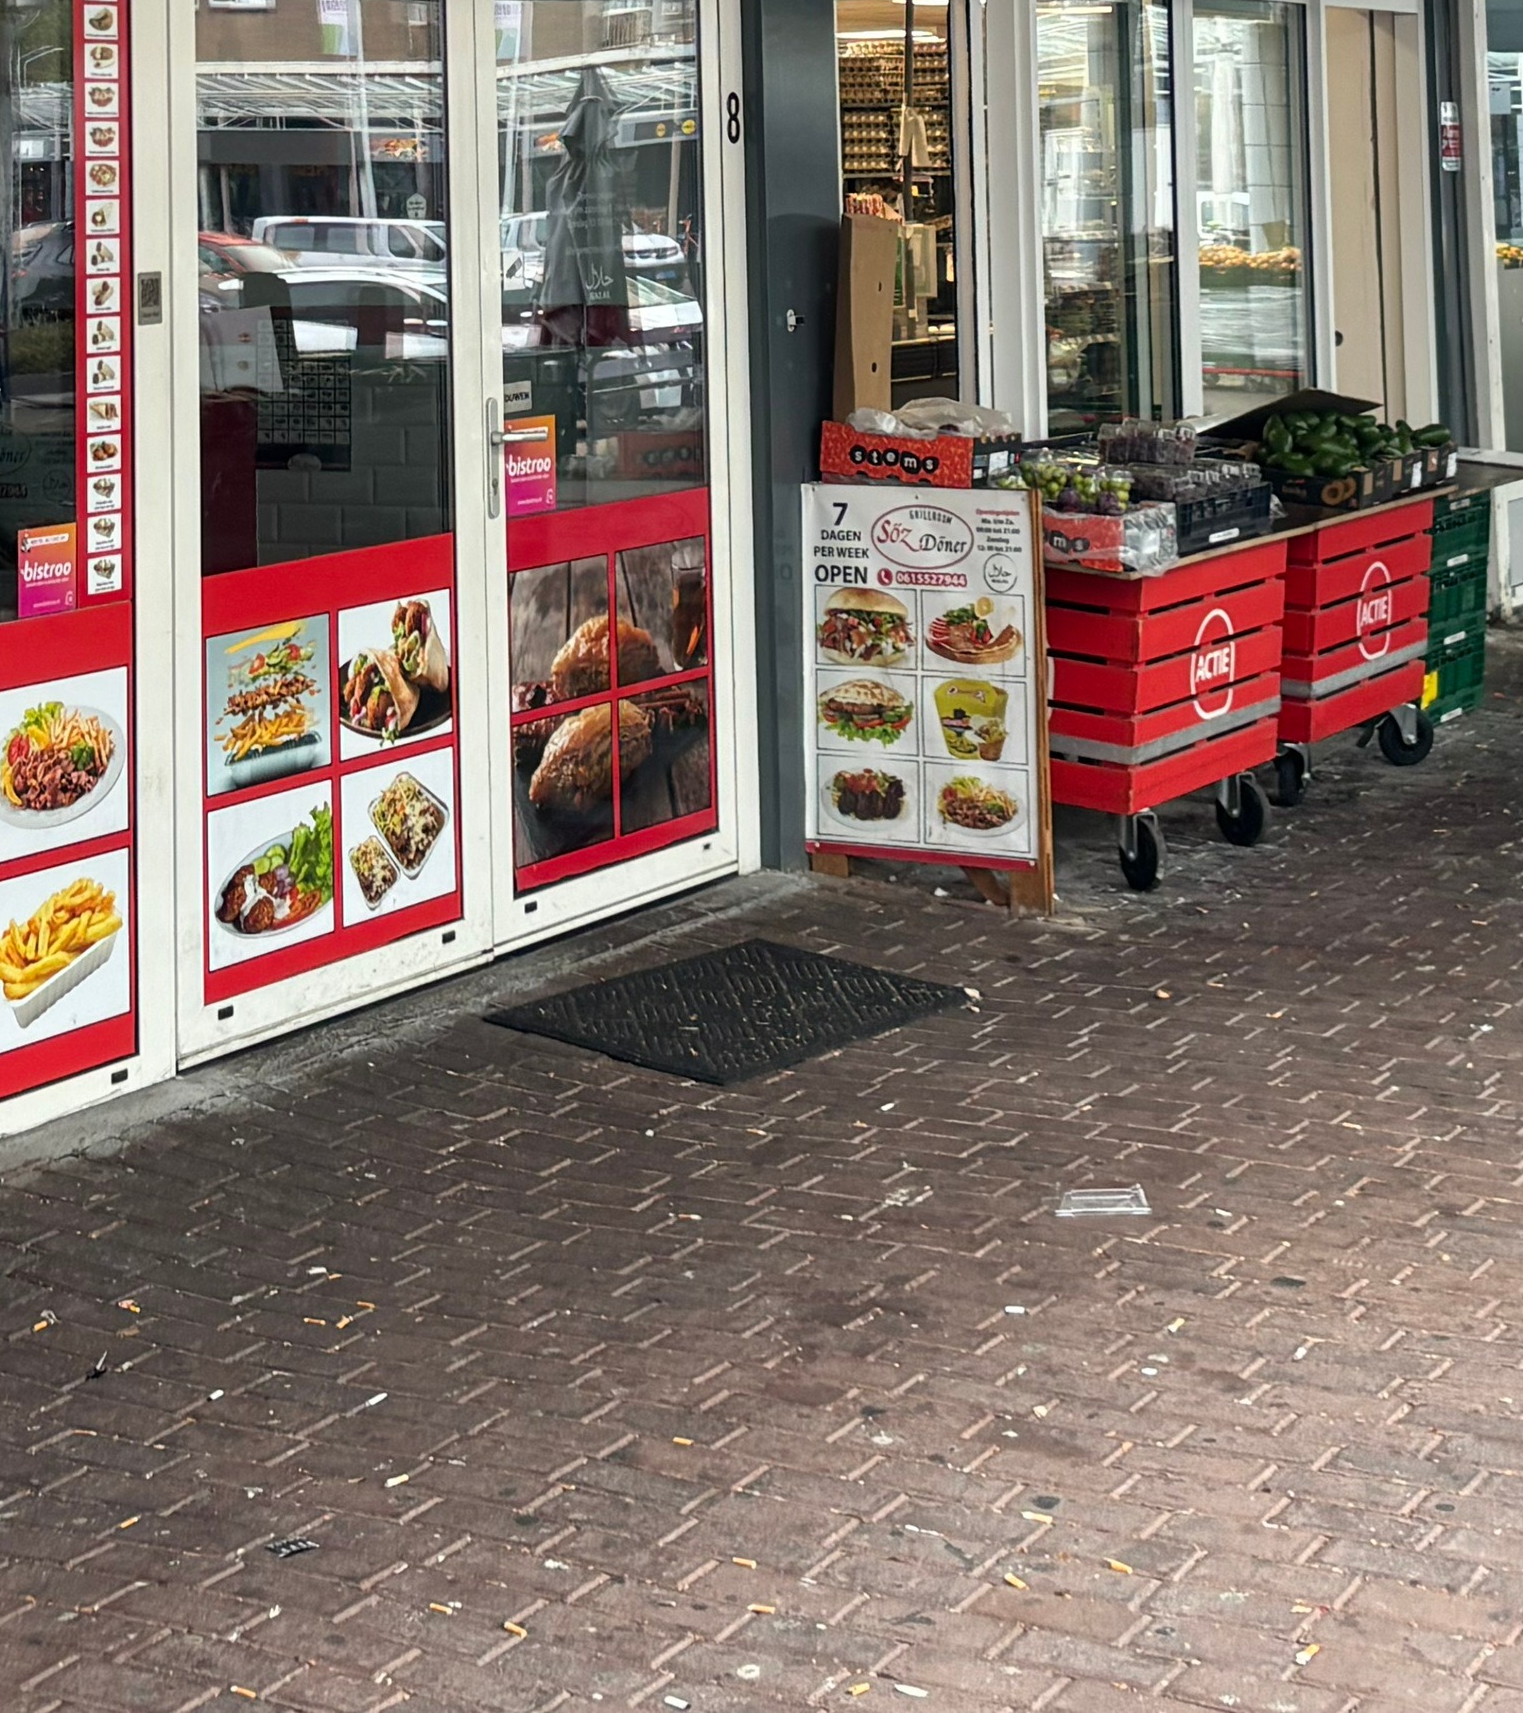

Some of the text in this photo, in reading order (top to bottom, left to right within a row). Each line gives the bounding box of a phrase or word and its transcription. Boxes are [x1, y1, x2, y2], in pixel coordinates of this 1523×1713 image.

[726, 91, 741, 145] 8
[508, 453, 552, 477] bistroo
[852, 447, 938, 473] stems
[831, 501, 849, 527] 7
[908, 509, 954, 526] GRILLROOM
[820, 530, 862, 542] DAGEN
[877, 519, 967, 554] Söz Döner
[813, 545, 869, 559] PER WEEK
[23, 560, 72, 583] bistroo
[814, 564, 869, 584] OPEN
[895, 571, 967, 587] 0615527944
[1360, 595, 1389, 628] ACTIE
[1195, 646, 1230, 683] ACTIE
